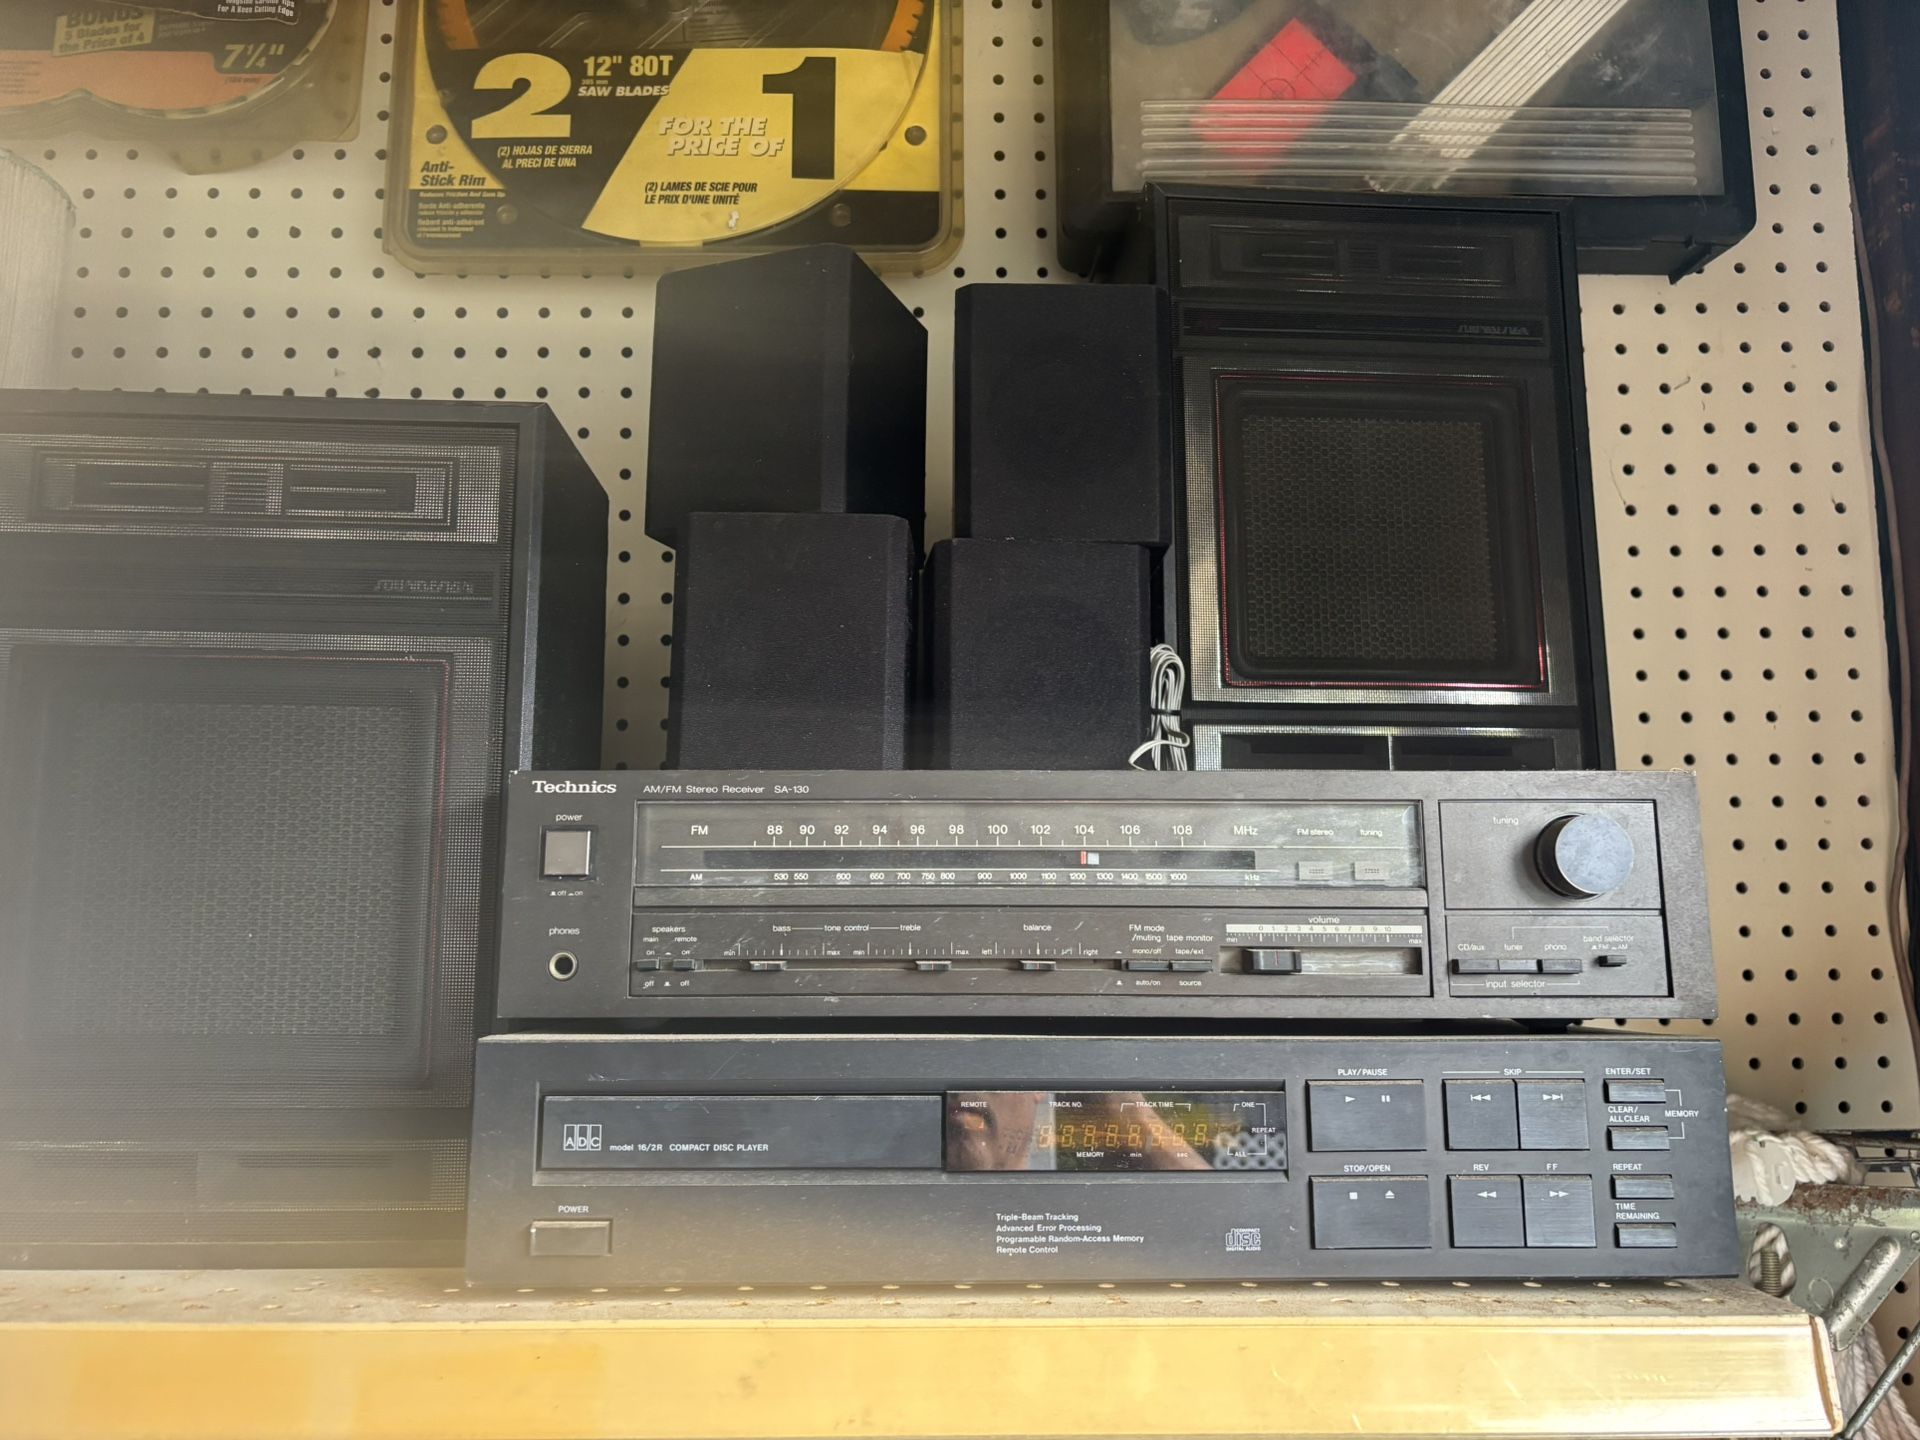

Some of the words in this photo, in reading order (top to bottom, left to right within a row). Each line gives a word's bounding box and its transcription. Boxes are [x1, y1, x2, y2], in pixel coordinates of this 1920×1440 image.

[218, 4, 229, 12] For
[583, 56, 622, 76] 12"
[629, 55, 674, 76] 80T
[471, 52, 572, 139] 2
[578, 86, 612, 97] SAW
[615, 85, 670, 97] BLADES
[762, 56, 836, 180] 1
[659, 117, 712, 136] FOR
[720, 117, 768, 136] THE
[497, 146, 511, 158] (2)
[512, 145, 542, 156] HOJAS
[544, 146, 557, 155] DE
[559, 145, 593, 155] SIERRA
[667, 137, 741, 156] PRICE
[750, 138, 785, 157] OF
[420, 161, 455, 173] Anti-
[502, 159, 514, 169] AL
[515, 158, 541, 169] PRECI
[543, 158, 556, 168] DE
[557, 157, 577, 168] UNA
[420, 175, 456, 186] Stick
[458, 175, 486, 186] Rim
[645, 182, 658, 193] (2)
[660, 182, 692, 192] LAMES
[694, 182, 706, 192] DE
[708, 182, 730, 192] SCIE
[732, 183, 758, 193] POUR
[645, 195, 656, 204] LE
[658, 195, 680, 204] PRIX
[682, 195, 711, 204] D'UNE
[713, 193, 740, 205] UNITÉ
[532, 780, 617, 794] Technics
[643, 785, 682, 794] AM/FM
[685, 785, 719, 794] Stereo
[722, 785, 765, 794] Receiver
[774, 785, 810, 794] SA-130
[556, 813, 583, 822] power
[1493, 816, 1519, 826] tuning
[691, 826, 708, 835] FM
[767, 825, 783, 835] 88
[799, 825, 815, 835] 90
[834, 825, 849, 835] 92
[872, 825, 887, 835] 94
[910, 825, 925, 835] 96
[949, 825, 964, 835] 98
[987, 825, 1008, 835] 100
[1031, 825, 1051, 835] 102
[1074, 825, 1095, 835] 104
[1119, 825, 1141, 835] 106
[1171, 825, 1193, 835] 108
[1234, 825, 1258, 836] MHz
[1360, 829, 1383, 838] tuning
[774, 872, 788, 881] 530
[794, 872, 808, 881] 550
[836, 872, 851, 881] 600
[870, 872, 885, 881] 650
[897, 872, 911, 881] 700
[921, 872, 935, 881] 750
[940, 872, 955, 881] 800
[977, 872, 992, 881] 900
[1010, 872, 1027, 881] 1000
[1041, 872, 1057, 881] 1100
[1070, 873, 1086, 881] 1200
[1096, 873, 1113, 881] 1300
[1121, 873, 1138, 881] 1400
[1146, 873, 1163, 881] 1500
[1170, 873, 1187, 881] 1600
[1308, 916, 1340, 924] volume
[549, 926, 580, 936] phones
[652, 926, 686, 934] speakers
[773, 924, 791, 932] bass
[824, 924, 841, 932] tone
[844, 924, 869, 932] control
[900, 924, 921, 932] treble
[1143, 924, 1165, 932] mode
[1132, 934, 1161, 942] /muting
[1166, 935, 1184, 943] tape
[1186, 934, 1214, 942] monitor
[1583, 934, 1602, 942] band
[1604, 934, 1634, 942] selector
[1132, 947, 1162, 955] mono/off
[1175, 947, 1204, 955] tape/ext
[1458, 943, 1485, 951] CD/aux
[1544, 943, 1567, 952] phono
[1083, 949, 1098, 957] right
[1486, 979, 1507, 989] input
[1511, 979, 1546, 988] selector
[1503, 1068, 1522, 1076] SKIP
[1605, 1068, 1651, 1076] ENTER/SET
[1607, 1106, 1638, 1114] CLEAR/
[610, 1143, 634, 1152] model
[638, 1143, 663, 1152] 16/2R
[669, 1143, 711, 1152] COMPACT
[713, 1143, 735, 1152] DISC
[736, 1143, 769, 1152] PLAYER
[1343, 1164, 1391, 1173] STOP/OPEN
[1473, 1163, 1489, 1171] REV
[1546, 1163, 1558, 1171] FF
[1612, 1163, 1642, 1171] REPEAT
[558, 1205, 589, 1213] POWER
[996, 1213, 1044, 1222] Triple-Beam
[1045, 1213, 1078, 1222] Tracking
[1616, 1212, 1660, 1220] REMAINING
[996, 1224, 1034, 1232] Advanced
[1037, 1224, 1057, 1232] Error
[1058, 1224, 1102, 1233] Processing
[996, 1235, 1046, 1244] Programable
[1048, 1235, 1111, 1243] Random-Access
[1112, 1235, 1144, 1244] Memory
[1226, 1228, 1261, 1246] disc
[996, 1246, 1027, 1254] Remote
[1028, 1246, 1058, 1254] Control
